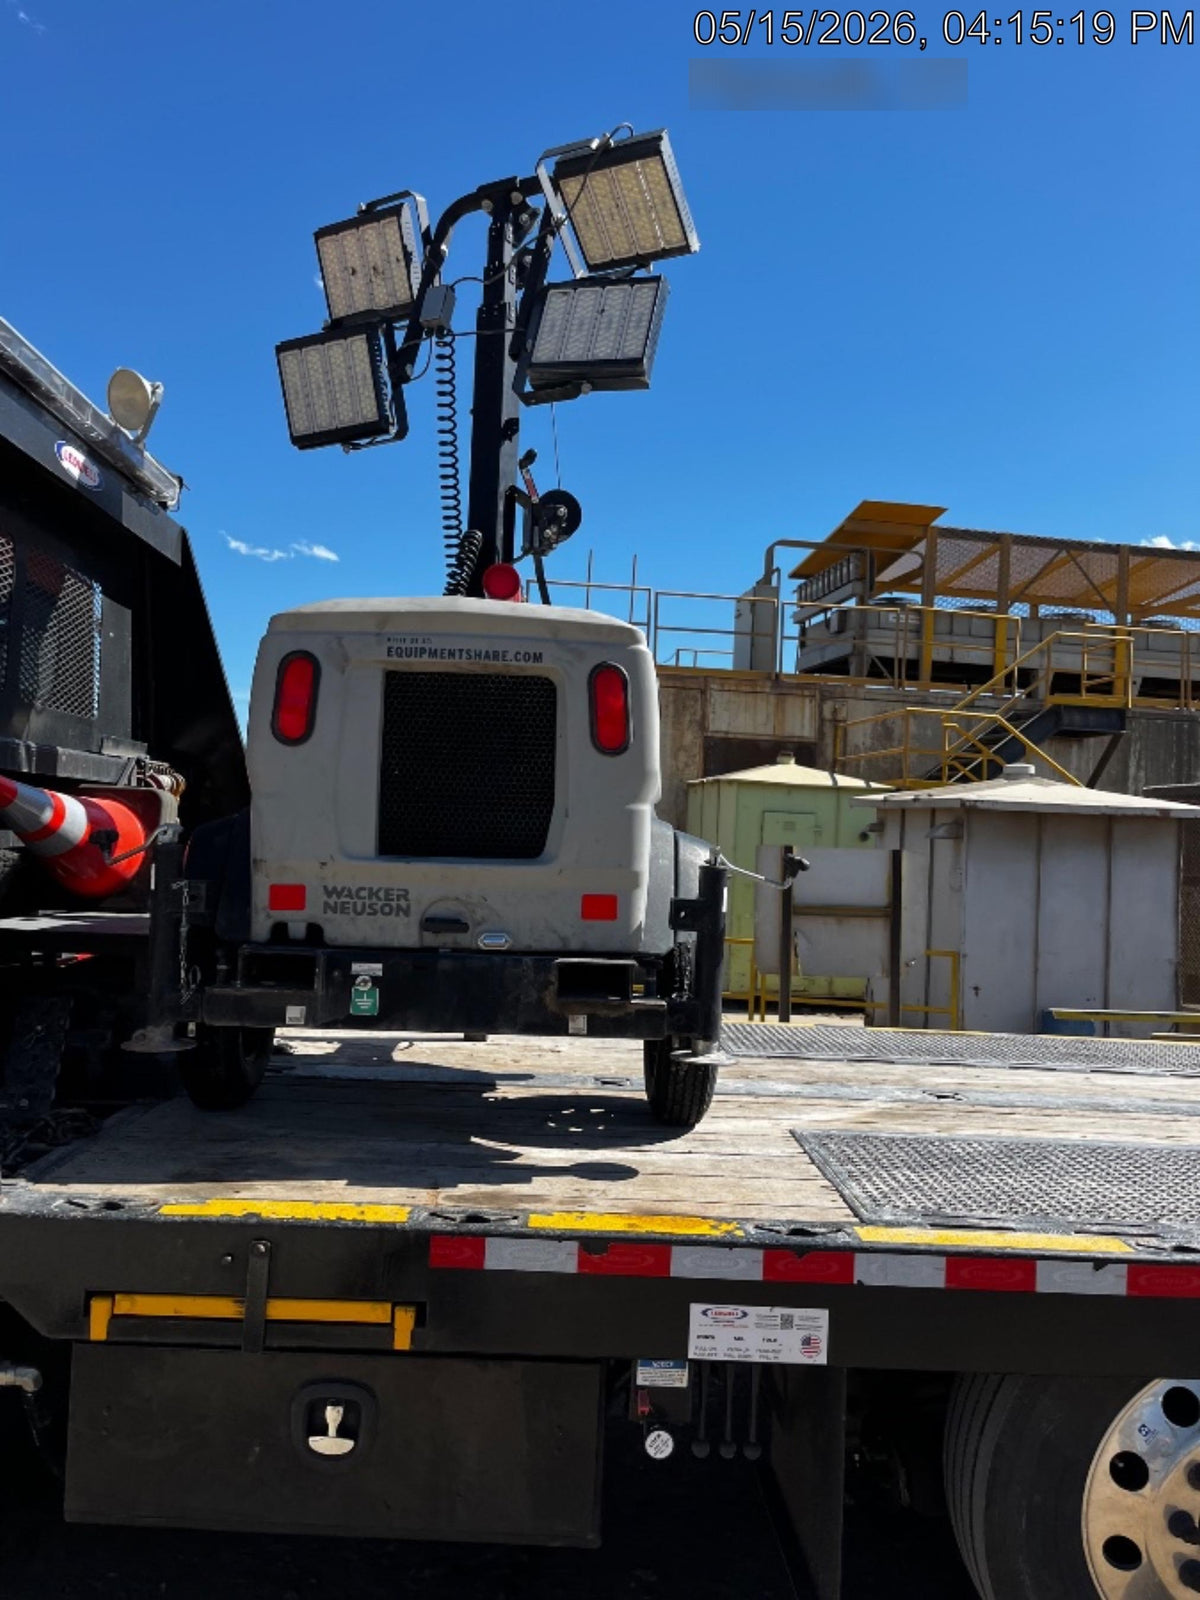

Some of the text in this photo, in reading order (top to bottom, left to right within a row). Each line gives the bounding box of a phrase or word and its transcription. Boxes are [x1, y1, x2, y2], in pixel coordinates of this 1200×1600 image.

[386, 645, 544, 664] EQUIPMENTSHARE.COM
[323, 884, 410, 902] WACKER
[323, 900, 411, 918] NEUSON
